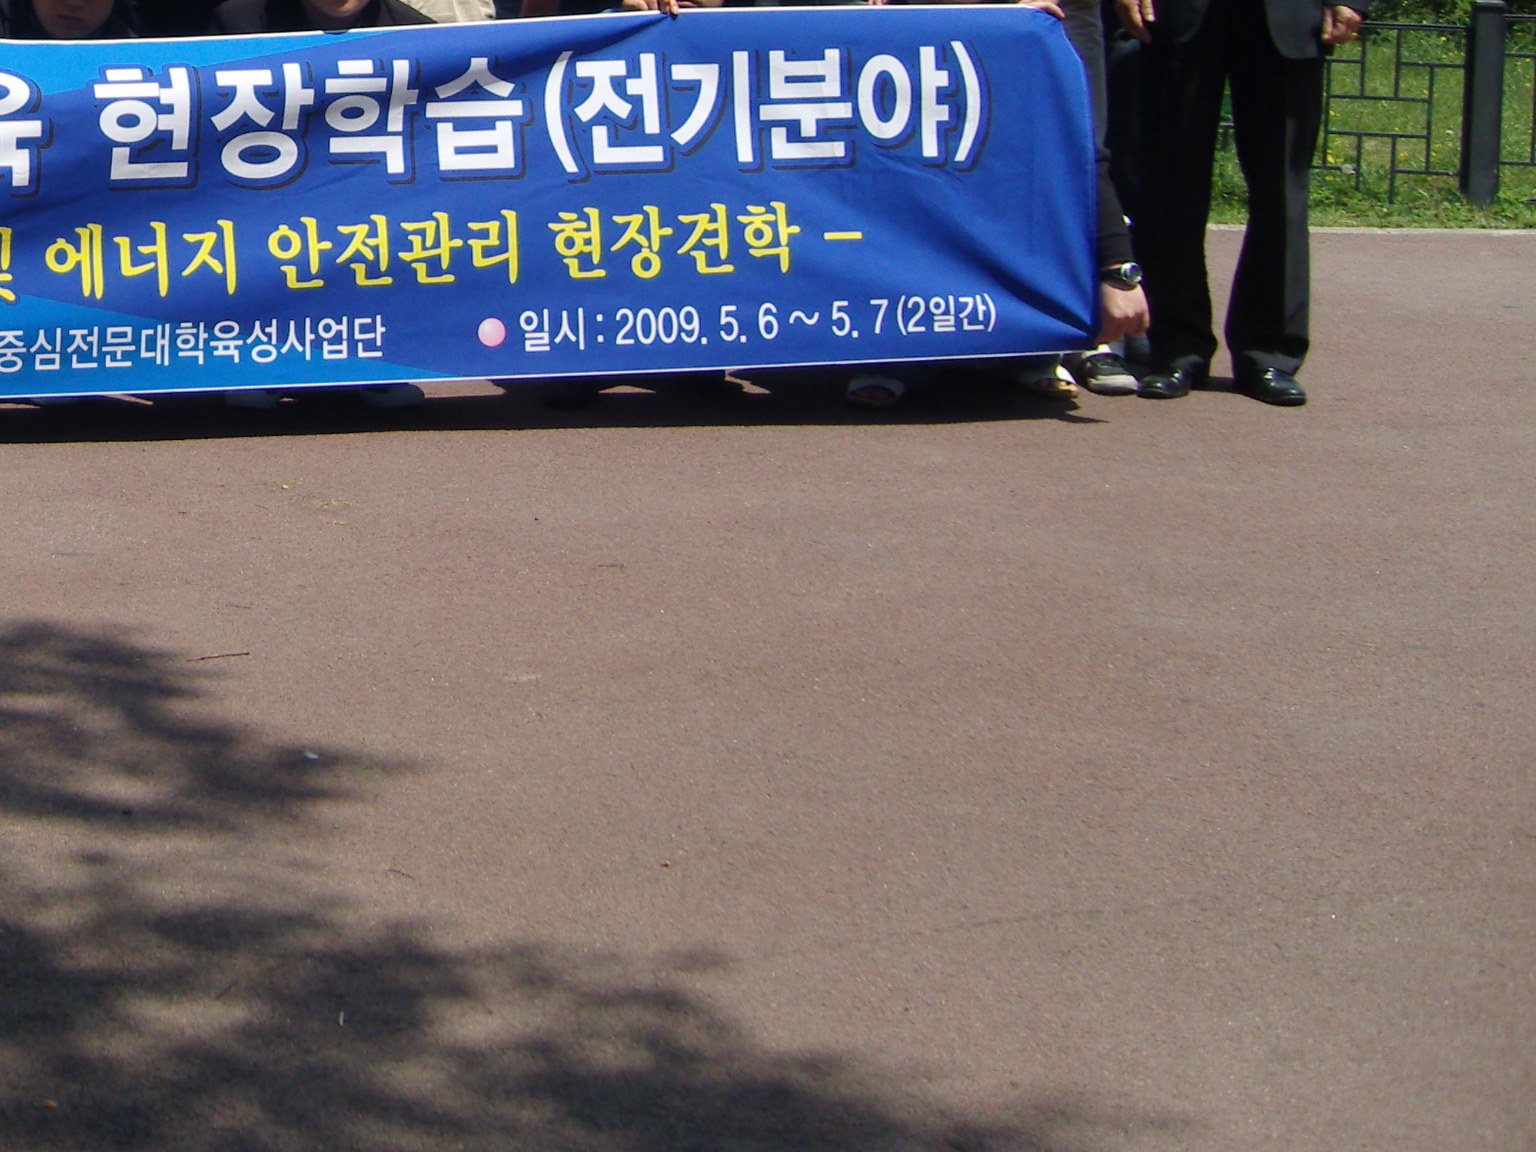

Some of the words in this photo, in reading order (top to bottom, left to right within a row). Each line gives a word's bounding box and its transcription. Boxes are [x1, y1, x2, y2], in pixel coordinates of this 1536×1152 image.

[93, 40, 982, 181] 현장학습(전기분야)
[45, 220, 237, 299] 에너지
[268, 210, 519, 289] 안전관리
[549, 202, 800, 280] 현장견학
